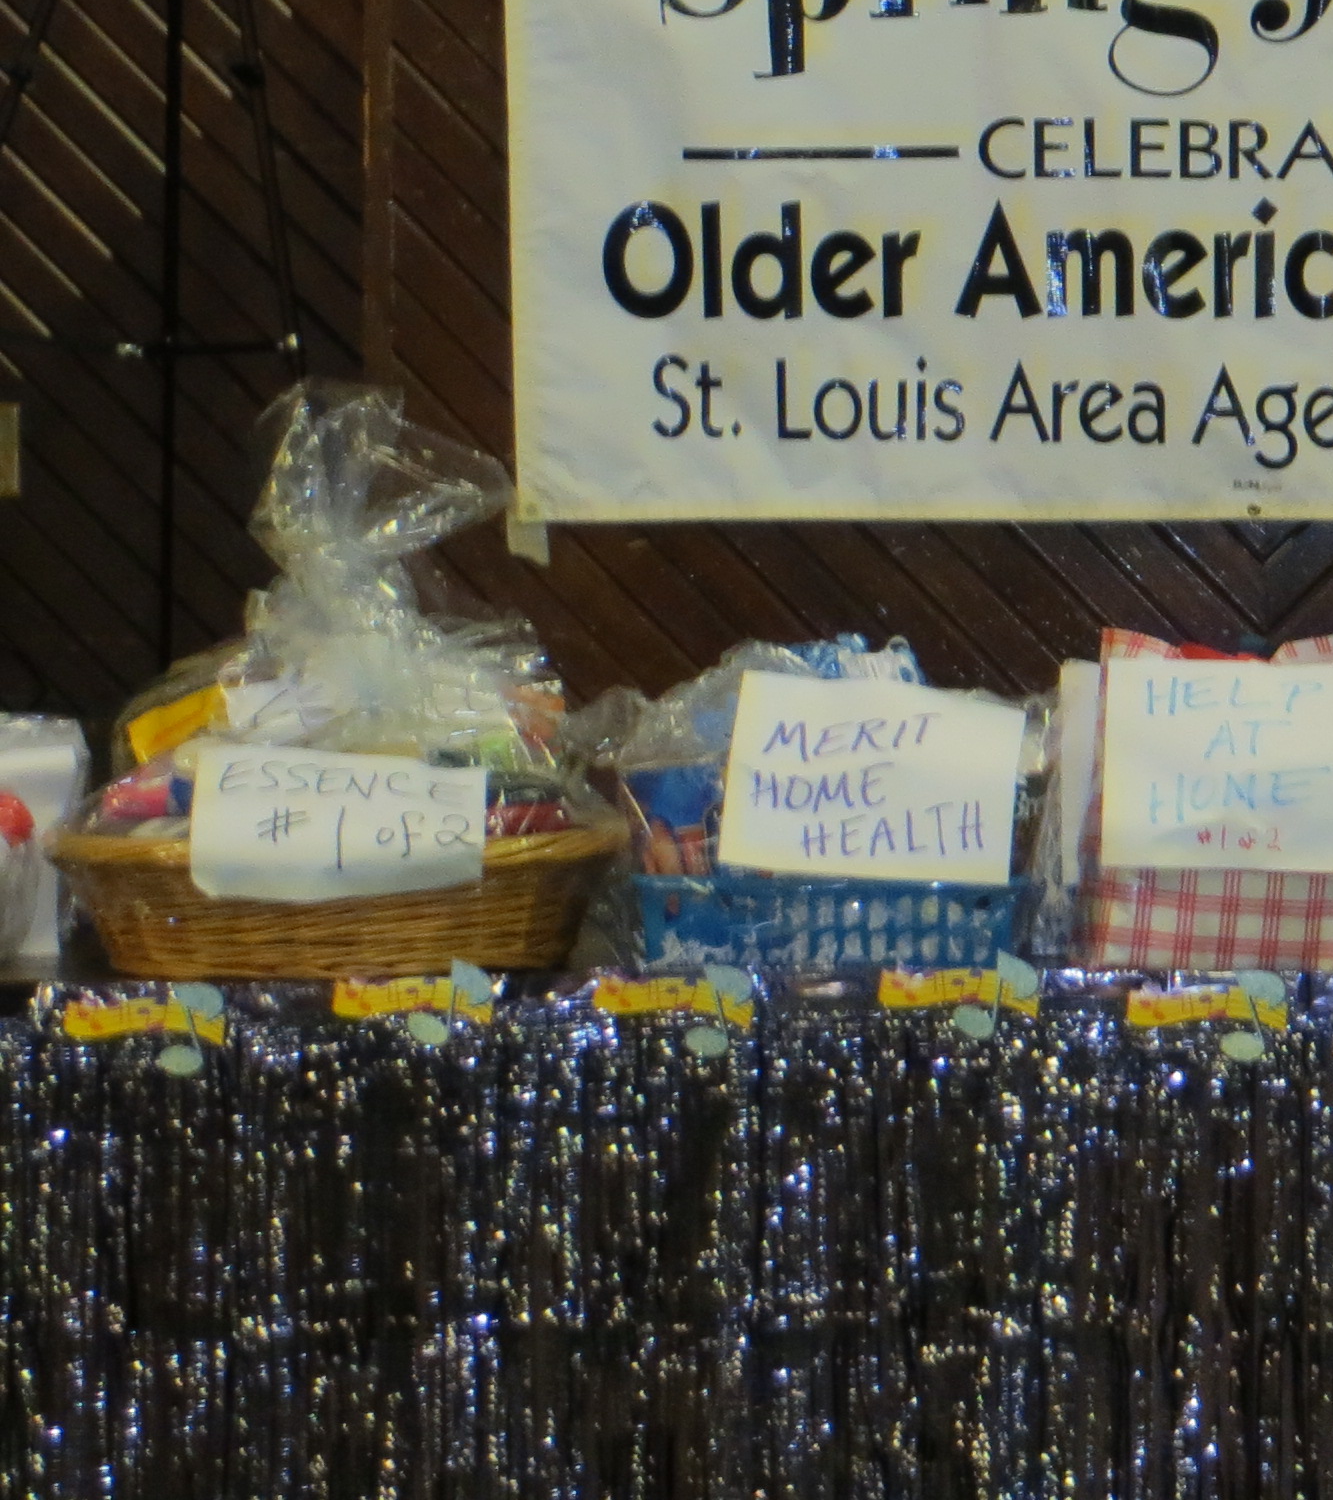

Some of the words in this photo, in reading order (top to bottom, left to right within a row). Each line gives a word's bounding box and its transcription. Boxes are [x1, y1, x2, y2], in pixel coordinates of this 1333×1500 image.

[602, 200, 922, 319] Older
[652, 354, 742, 439] St.
[776, 356, 966, 443] Louis
[989, 361, 1167, 445] Area
[1146, 676, 1323, 715] HELP
[762, 712, 942, 763] MERIT
[1203, 720, 1292, 760] AT
[219, 758, 474, 806] ESSENCE
[749, 761, 893, 813] HOME
[799, 801, 985, 858] HEALTH
